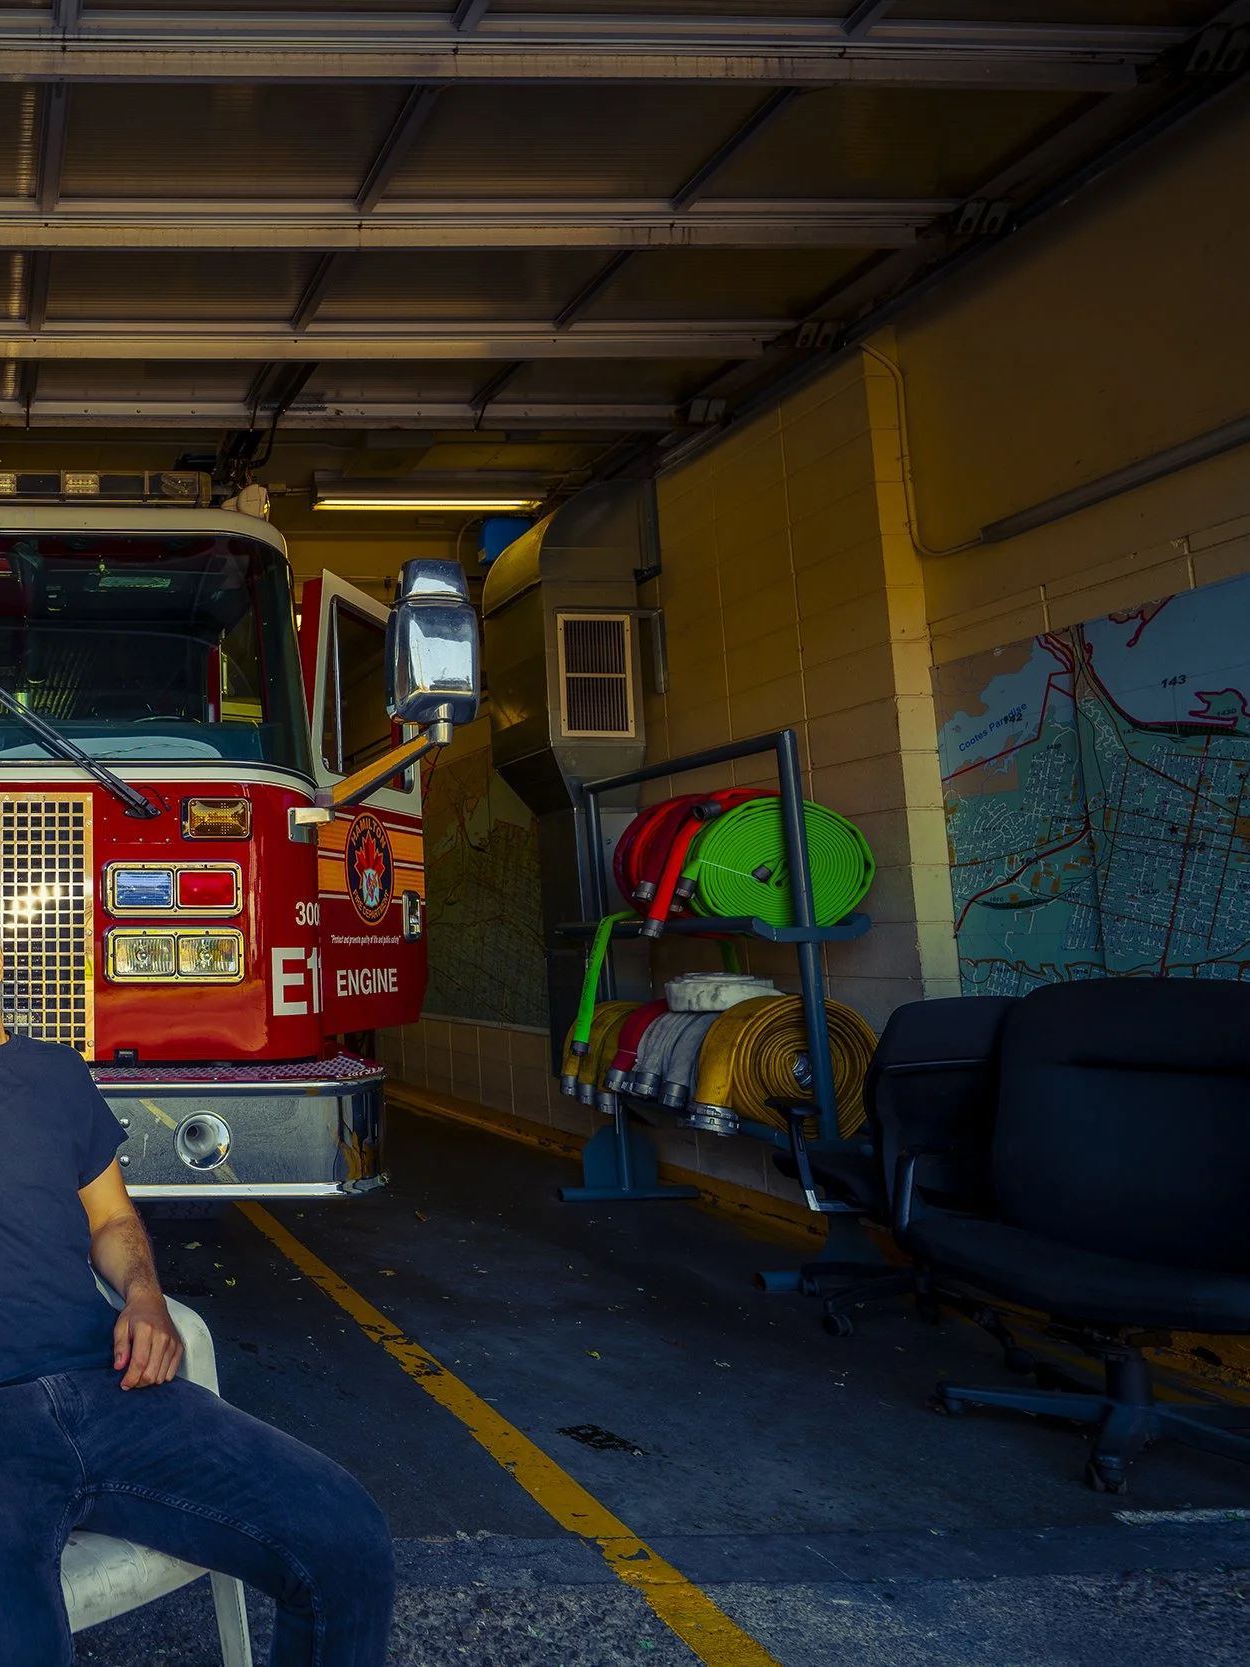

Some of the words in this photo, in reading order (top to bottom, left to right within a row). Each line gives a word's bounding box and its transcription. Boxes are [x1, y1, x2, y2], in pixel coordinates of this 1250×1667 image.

[1161, 674, 1186, 688] 143
[958, 730, 988, 752] Cootes
[989, 703, 1027, 732] Paradise
[350, 817, 387, 849] HAMILTON
[352, 888, 364, 912] FIRE
[362, 888, 390, 920] DEPARTMENT
[336, 968, 399, 997] ENGINE
